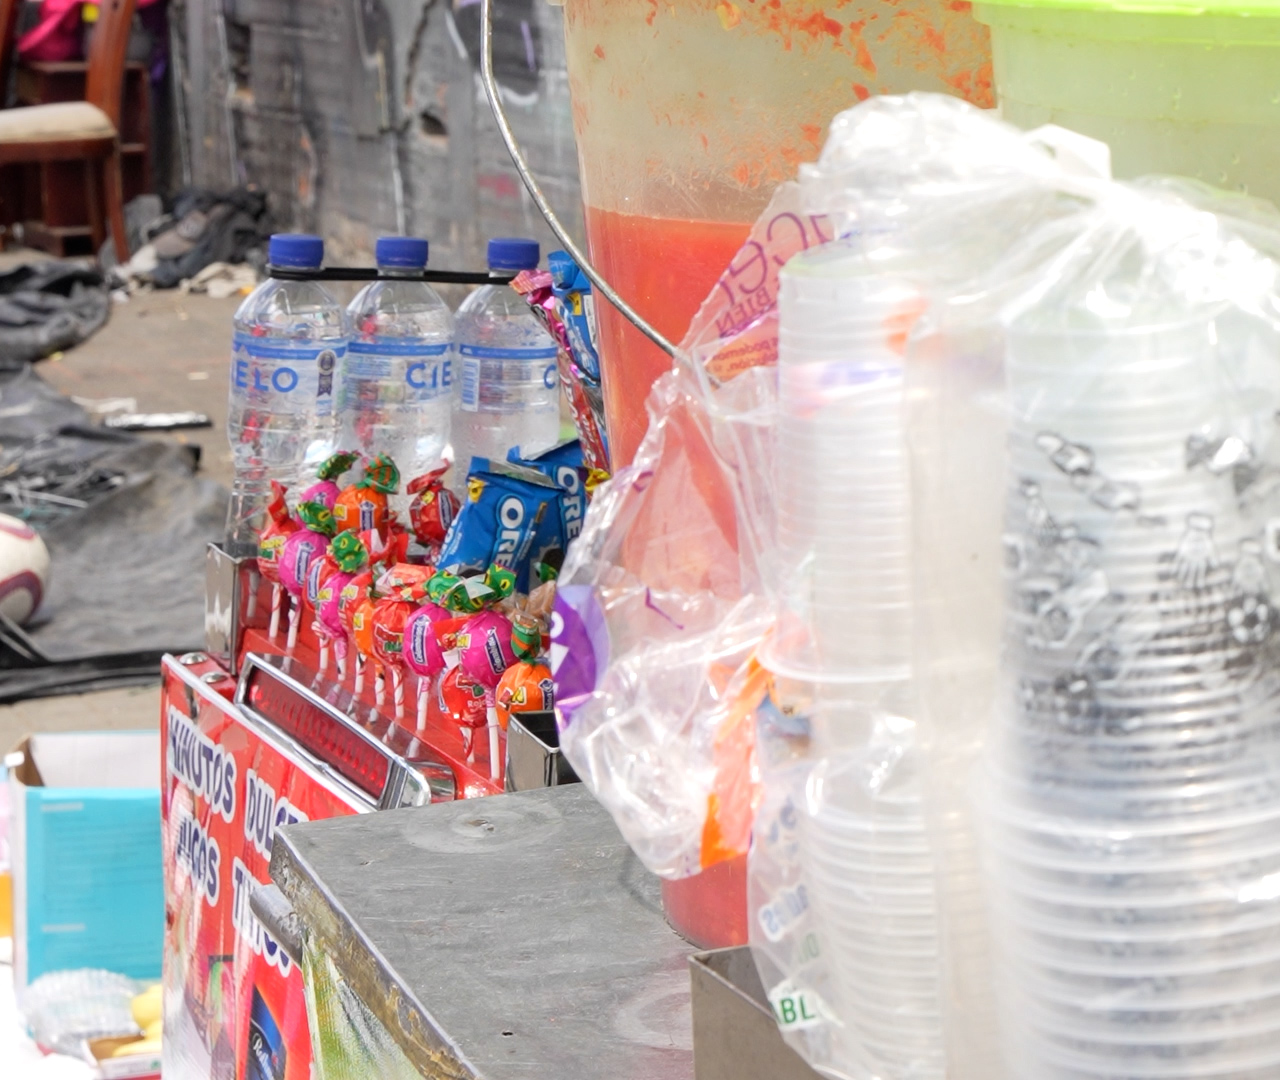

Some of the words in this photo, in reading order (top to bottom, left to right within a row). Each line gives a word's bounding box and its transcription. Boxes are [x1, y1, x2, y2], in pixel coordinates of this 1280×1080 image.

[235, 360, 299, 393] ELO
[405, 360, 453, 389] CIE
[495, 497, 524, 568] ORE
[557, 466, 581, 539] ORE
[170, 714, 234, 814] MINUTOS
[248, 777, 298, 851] DUL
[177, 818, 218, 898] JUGOS
